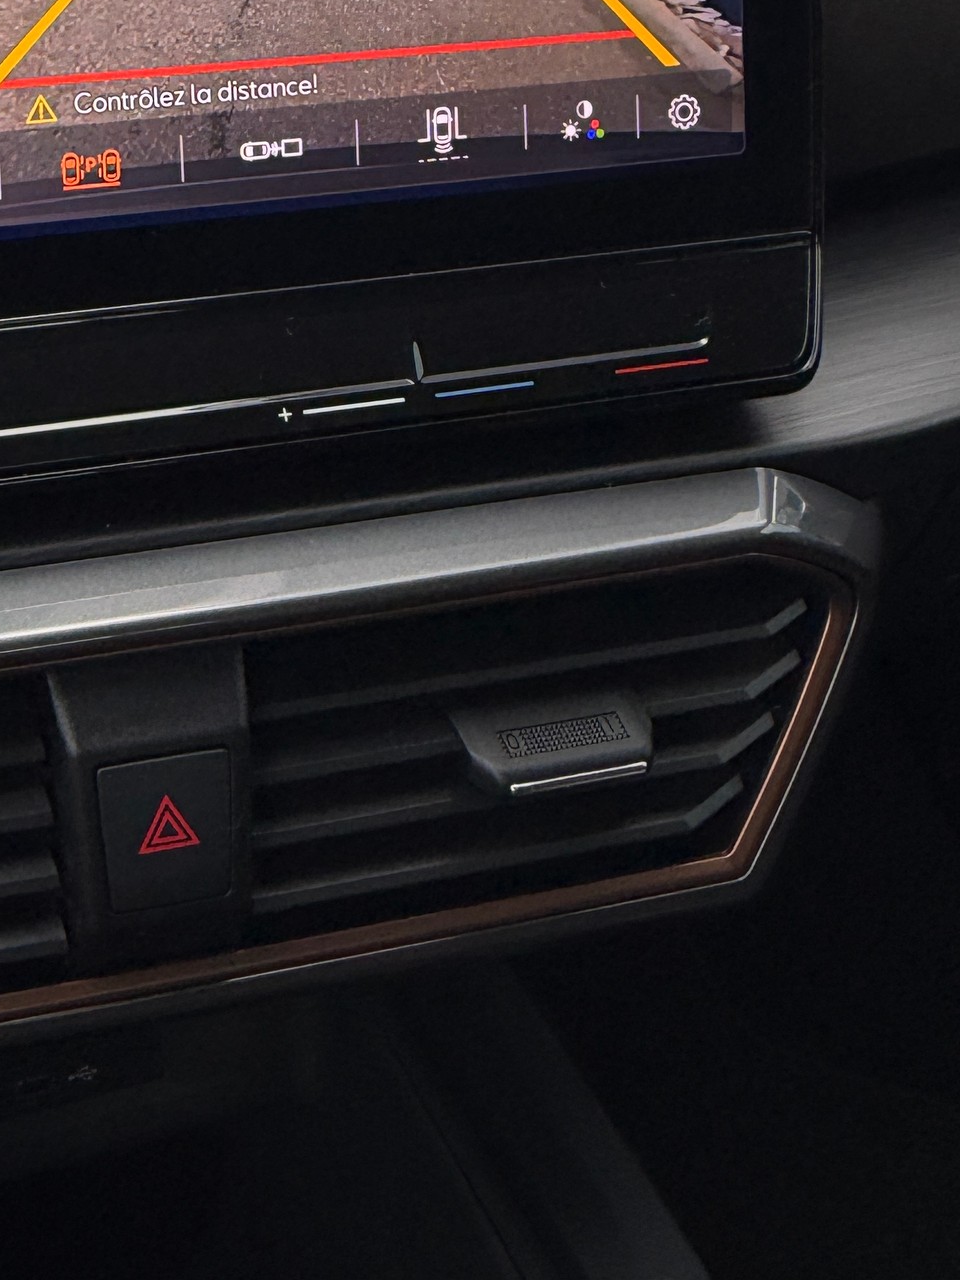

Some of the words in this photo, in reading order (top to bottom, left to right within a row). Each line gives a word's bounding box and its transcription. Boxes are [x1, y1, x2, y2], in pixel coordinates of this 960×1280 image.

[73, 87, 185, 115] Contrôlez
[190, 83, 212, 105] la
[217, 74, 319, 102] distance!
